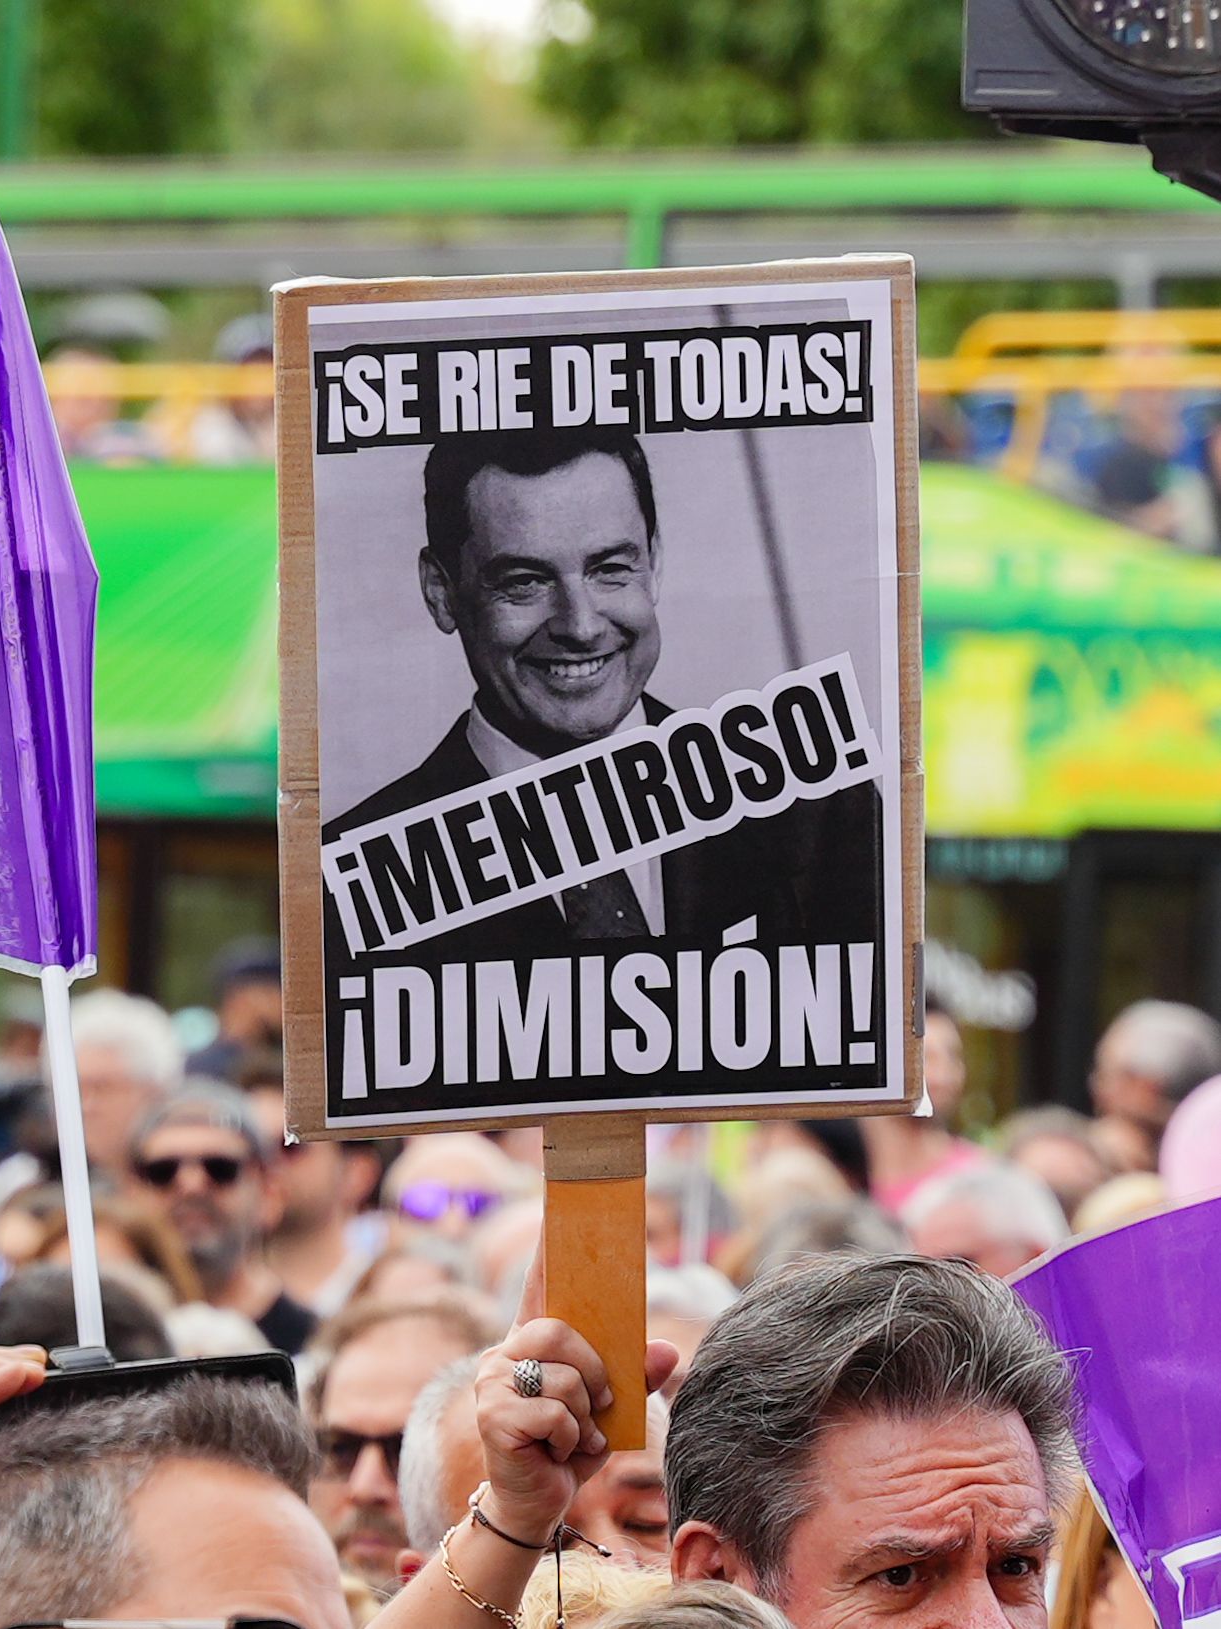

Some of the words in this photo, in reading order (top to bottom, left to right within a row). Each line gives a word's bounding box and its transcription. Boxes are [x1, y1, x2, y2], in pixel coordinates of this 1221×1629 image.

[324, 350, 422, 444] ¡SE
[437, 347, 534, 433] RIE
[549, 342, 631, 429] DE
[644, 331, 865, 423] TODAS!
[335, 671, 870, 952] ¡MENTIROSO!
[338, 914, 876, 1099] ¡DIMISIÓN!
